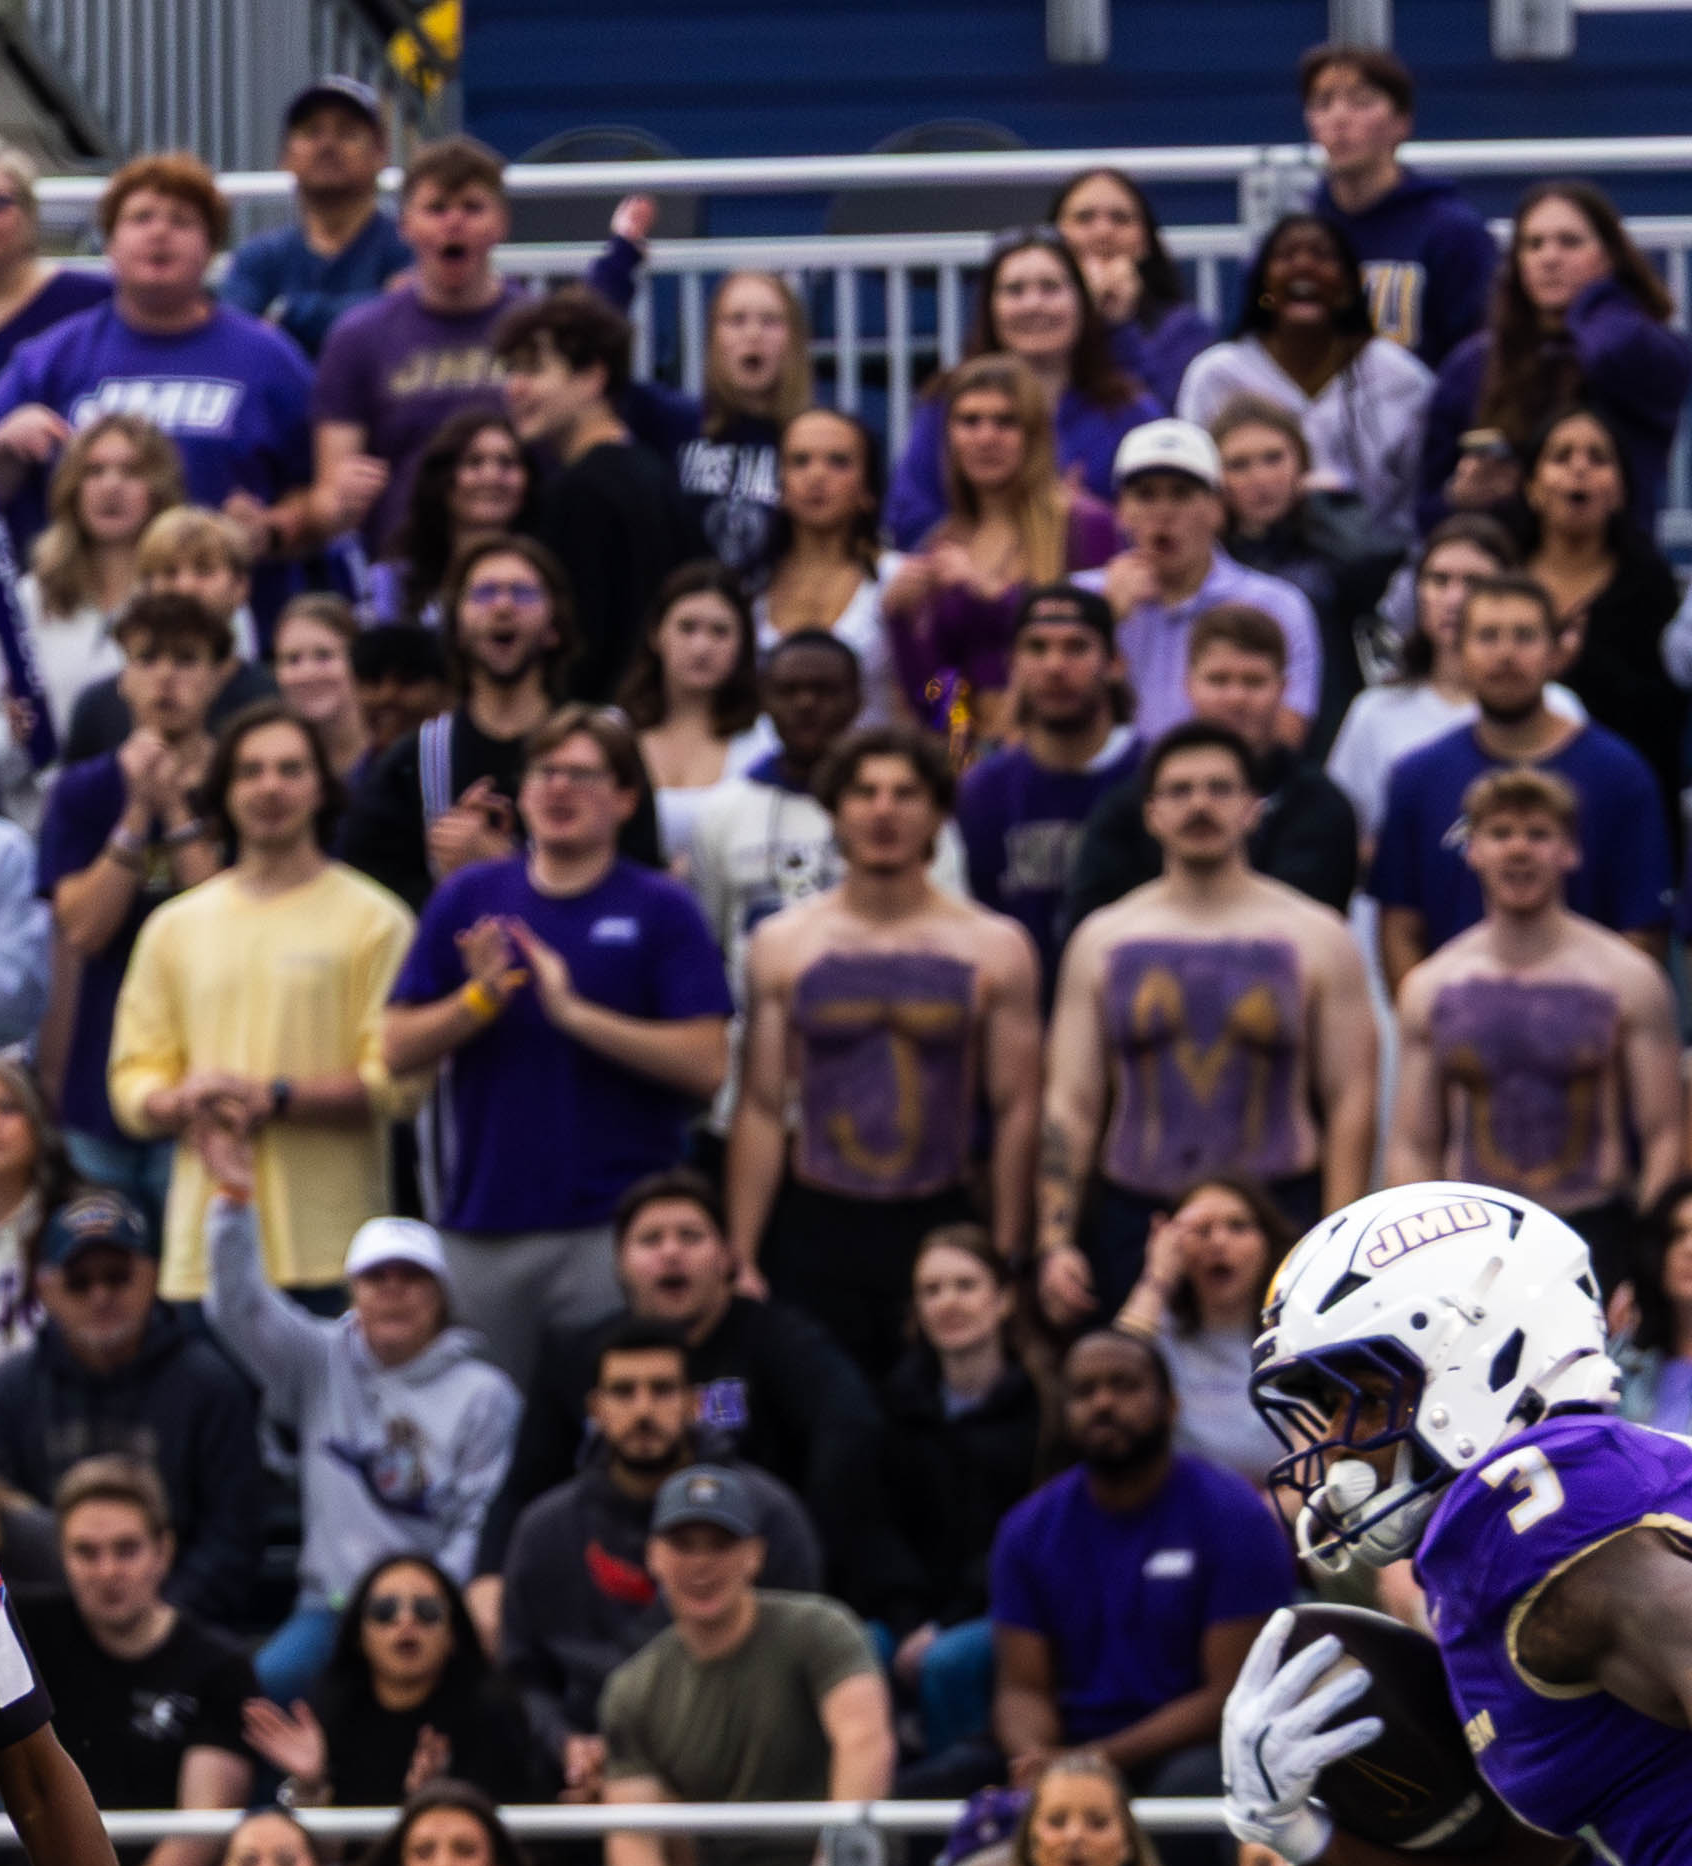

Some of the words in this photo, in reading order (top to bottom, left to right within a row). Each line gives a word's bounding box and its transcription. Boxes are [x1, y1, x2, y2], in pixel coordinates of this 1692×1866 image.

[70, 375, 245, 436] JMU
[815, 998, 963, 1178] J
[1131, 964, 1282, 1150] M
[1366, 1200, 1492, 1269] JMU
[1477, 1445, 1566, 1536] 3
